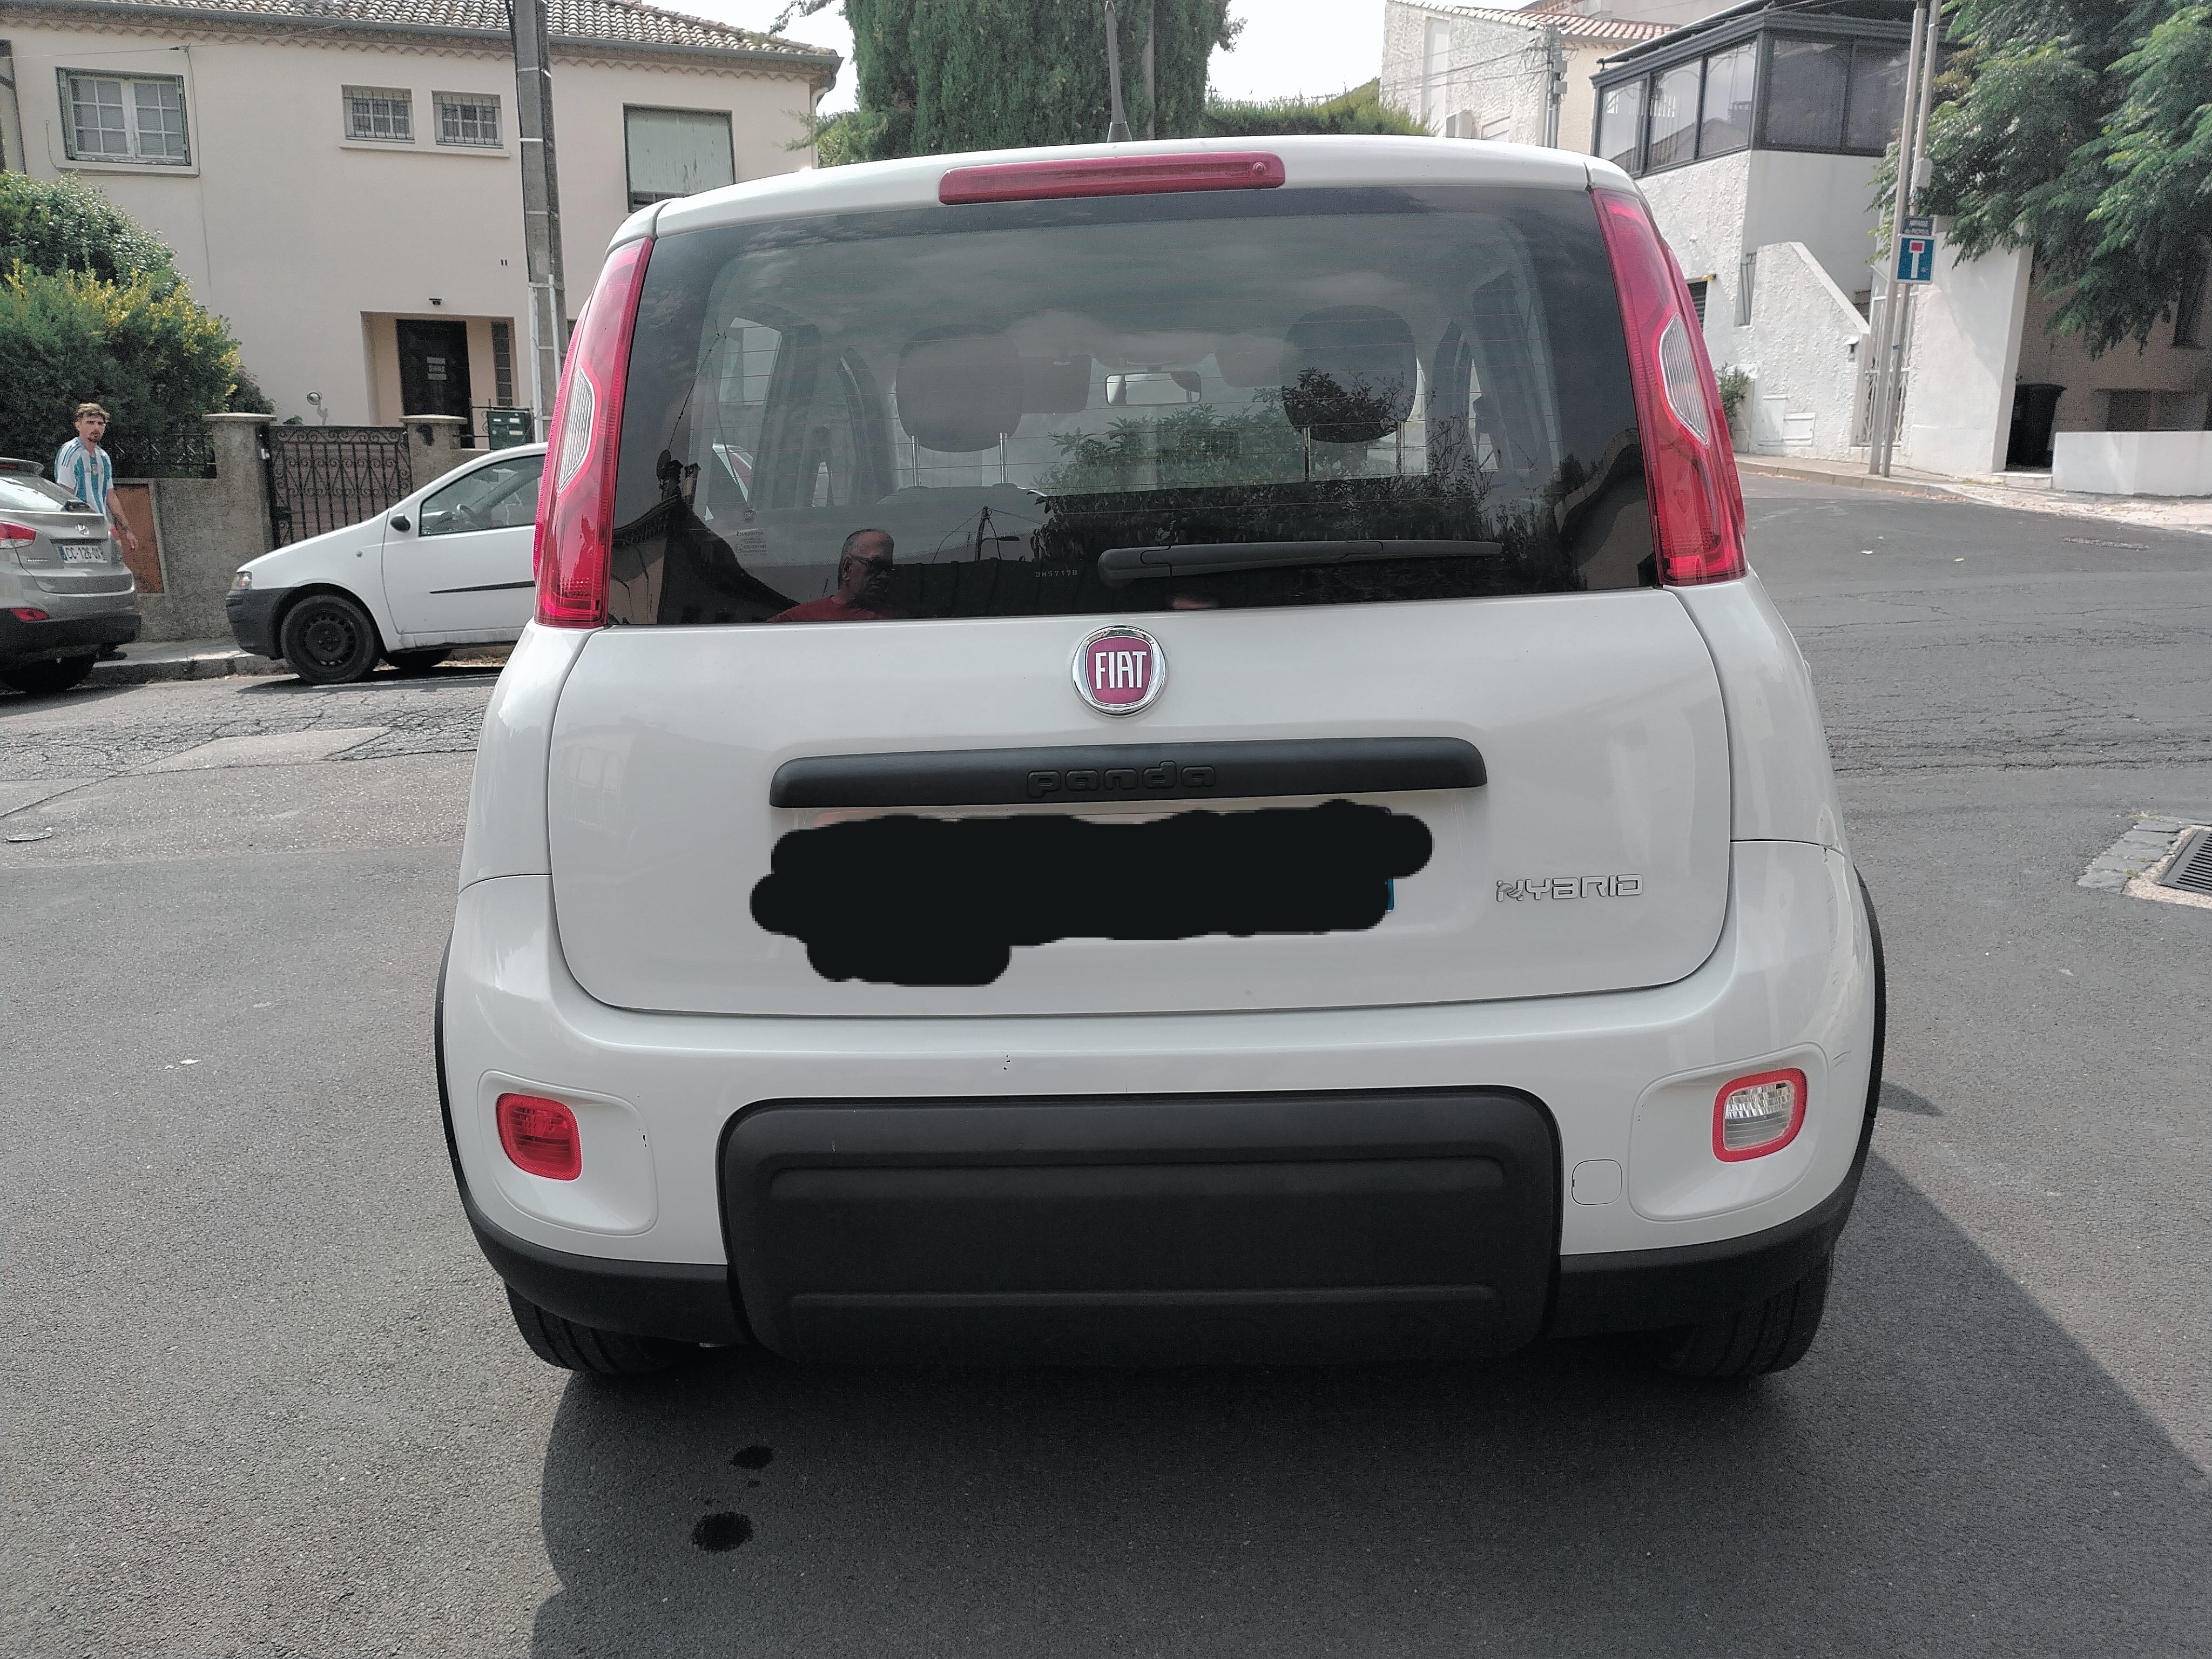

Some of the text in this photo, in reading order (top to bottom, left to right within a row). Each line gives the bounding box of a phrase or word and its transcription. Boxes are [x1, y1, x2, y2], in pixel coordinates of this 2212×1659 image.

[1095, 651, 1147, 690] FIAT
[1027, 760, 1216, 798] panda
[1495, 874, 1643, 902] HYBRID
